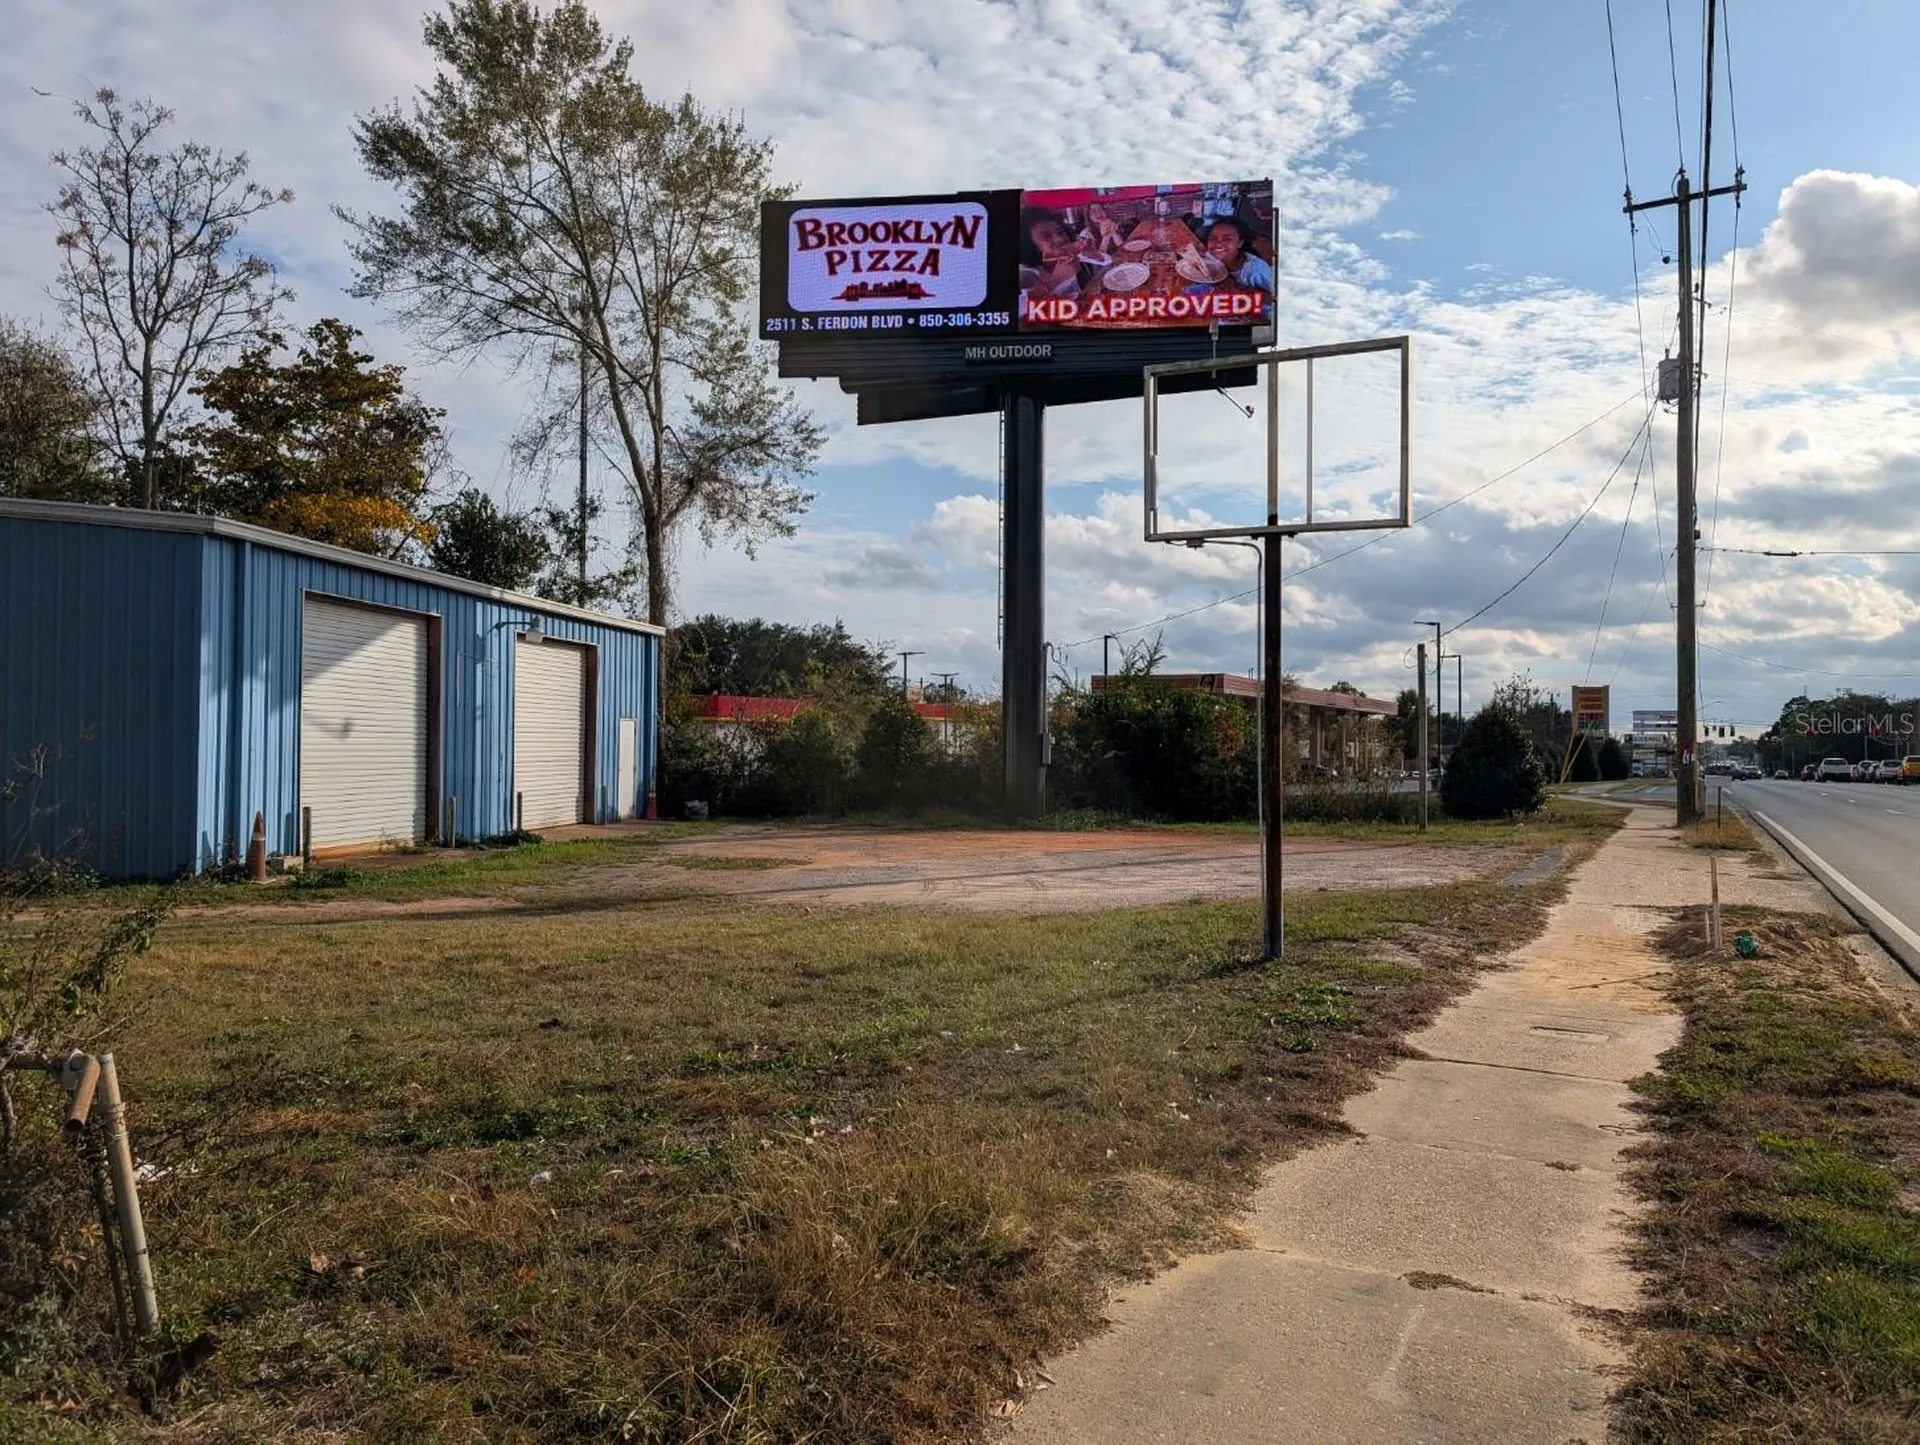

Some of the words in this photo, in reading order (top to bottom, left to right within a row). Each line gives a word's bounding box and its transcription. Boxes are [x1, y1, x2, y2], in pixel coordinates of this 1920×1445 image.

[794, 215, 983, 251] BROOKLYN
[825, 248, 940, 276] PIZZA
[1028, 300, 1079, 321] KID
[1087, 292, 1264, 319] APPROVED!
[766, 318, 796, 331] 2511
[801, 318, 813, 330] S.
[818, 315, 868, 329] FERDON
[872, 314, 903, 328] BLVD
[919, 312, 1010, 327] 850-306-3355
[965, 347, 986, 360] MH
[989, 344, 1052, 358] OUTDOOR
